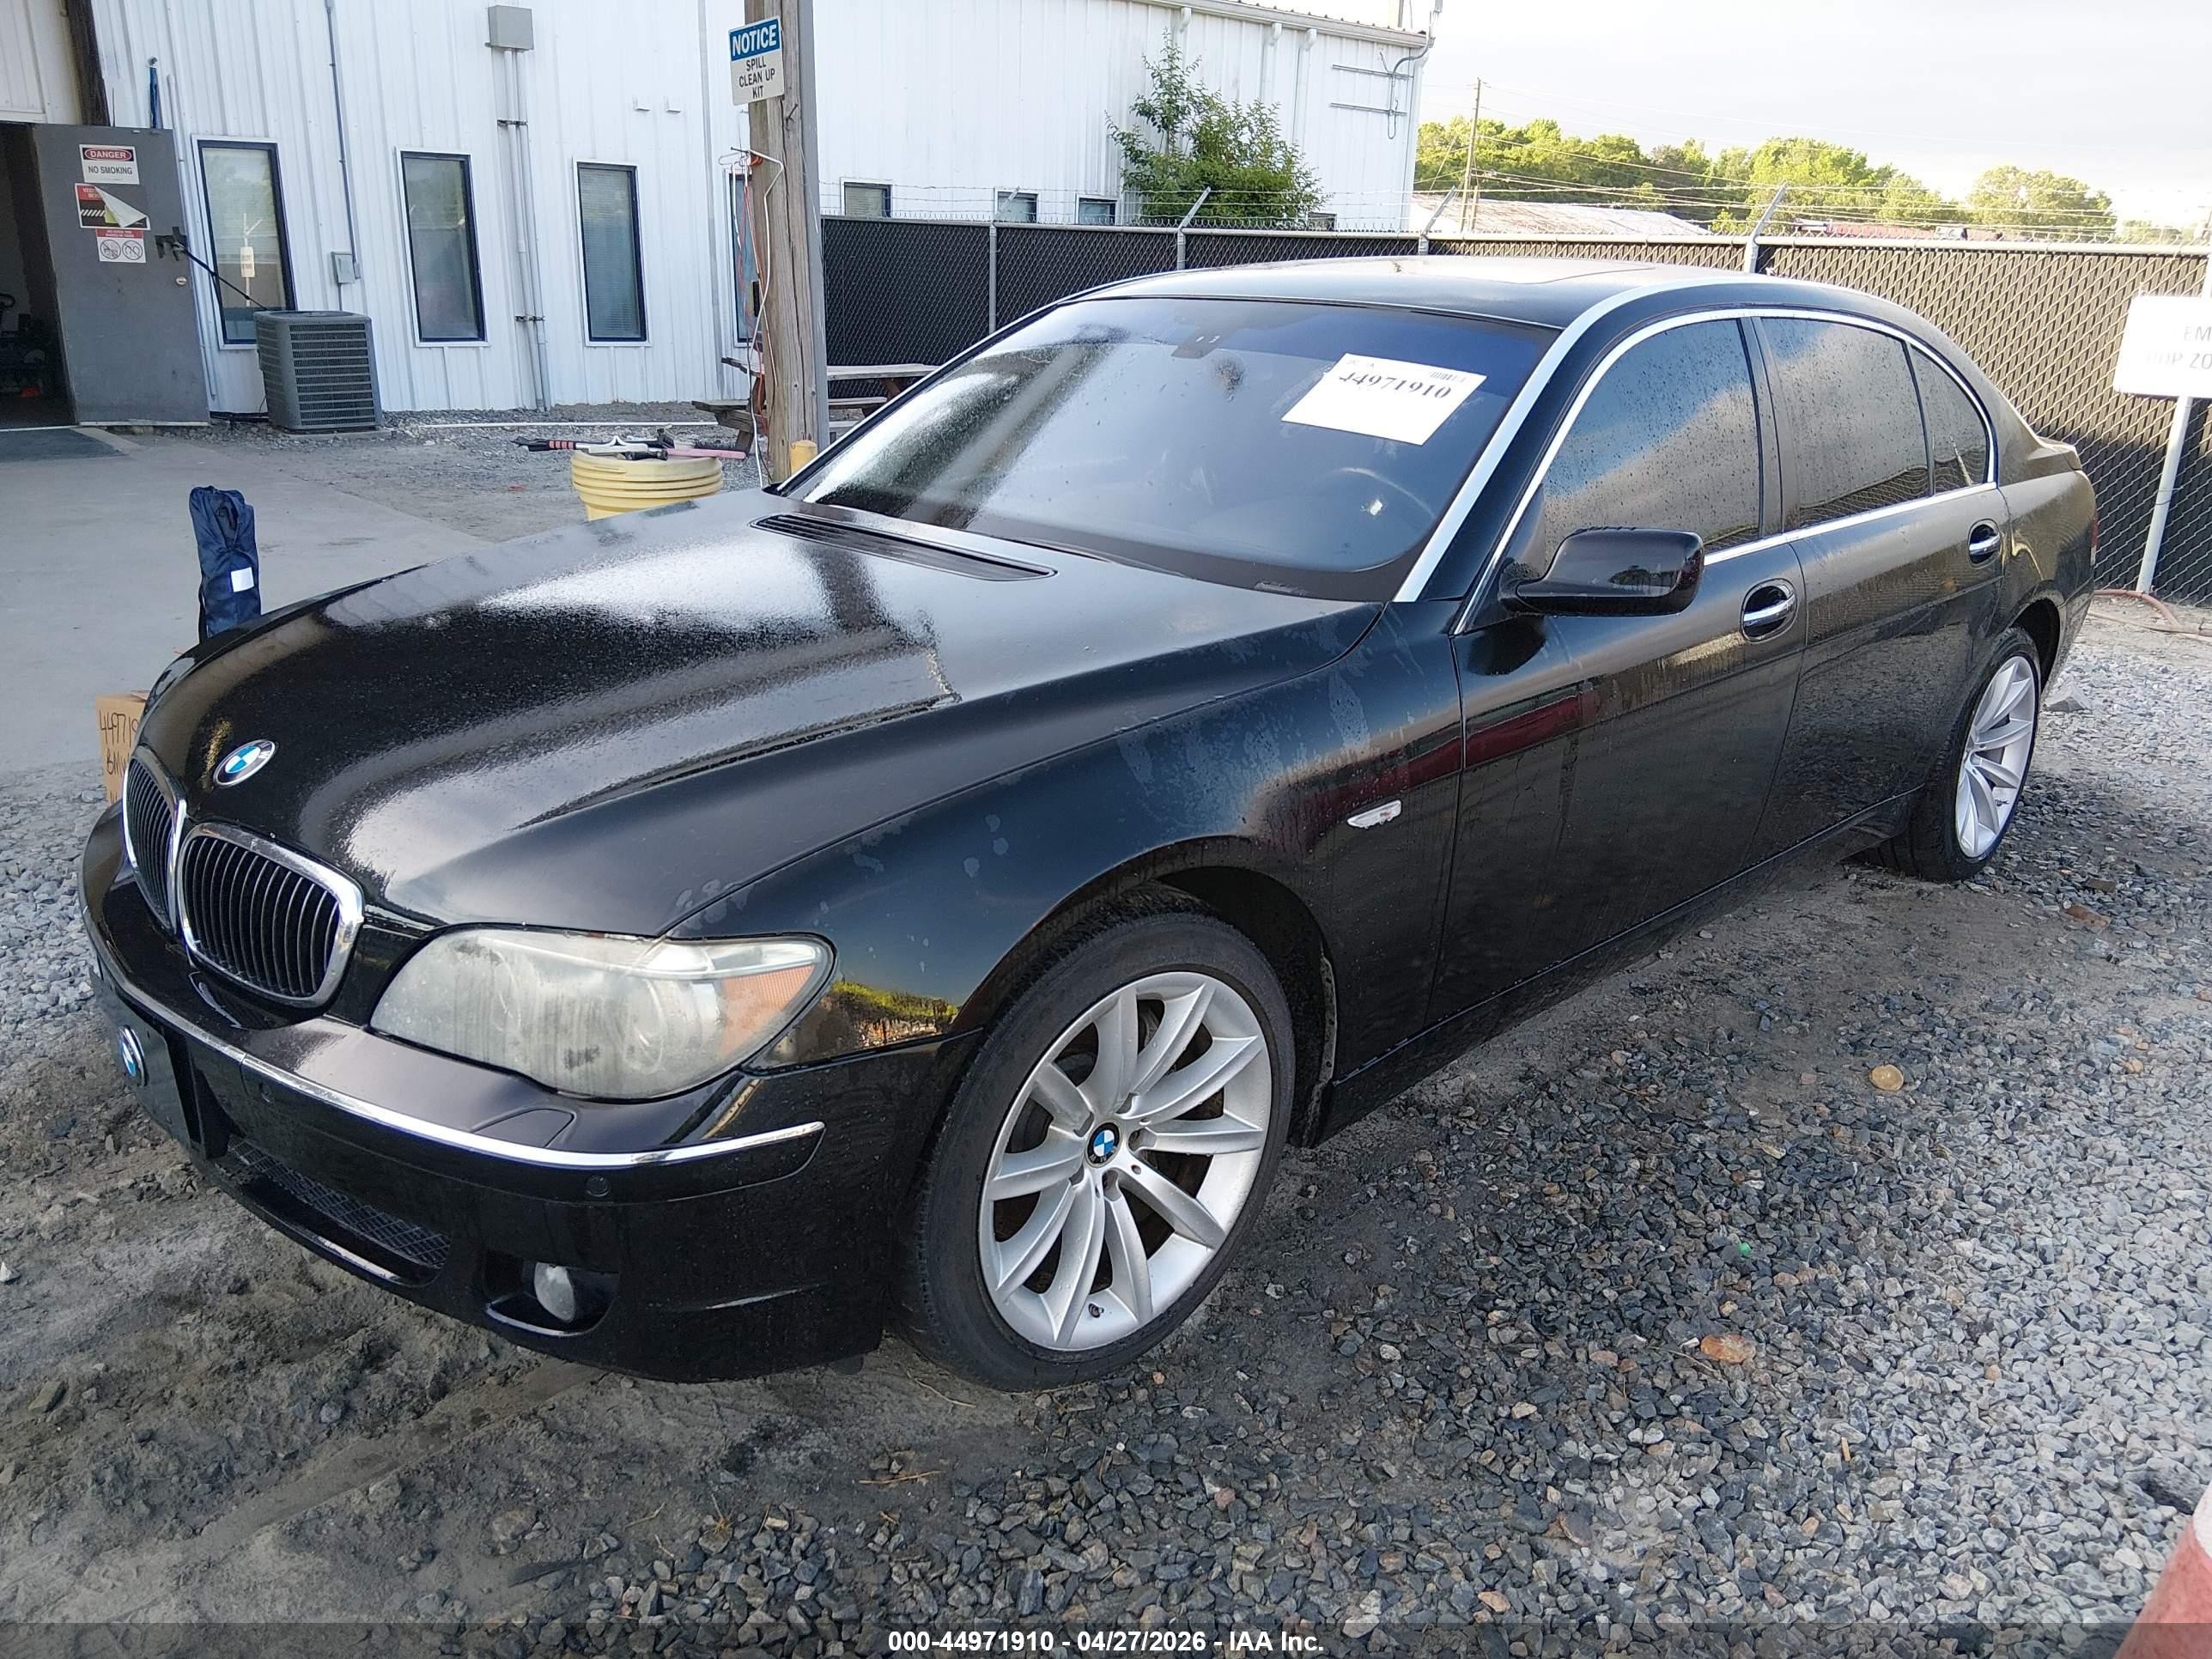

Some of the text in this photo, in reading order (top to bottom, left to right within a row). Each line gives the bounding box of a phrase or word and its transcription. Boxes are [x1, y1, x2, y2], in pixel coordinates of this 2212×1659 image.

[732, 24, 777, 57] NOTICE
[746, 56, 767, 71] SPILL
[738, 68, 775, 88] CLEAN UP
[752, 86, 764, 100] KIT
[89, 150, 127, 159] DANGER
[100, 166, 133, 174] SMOKING
